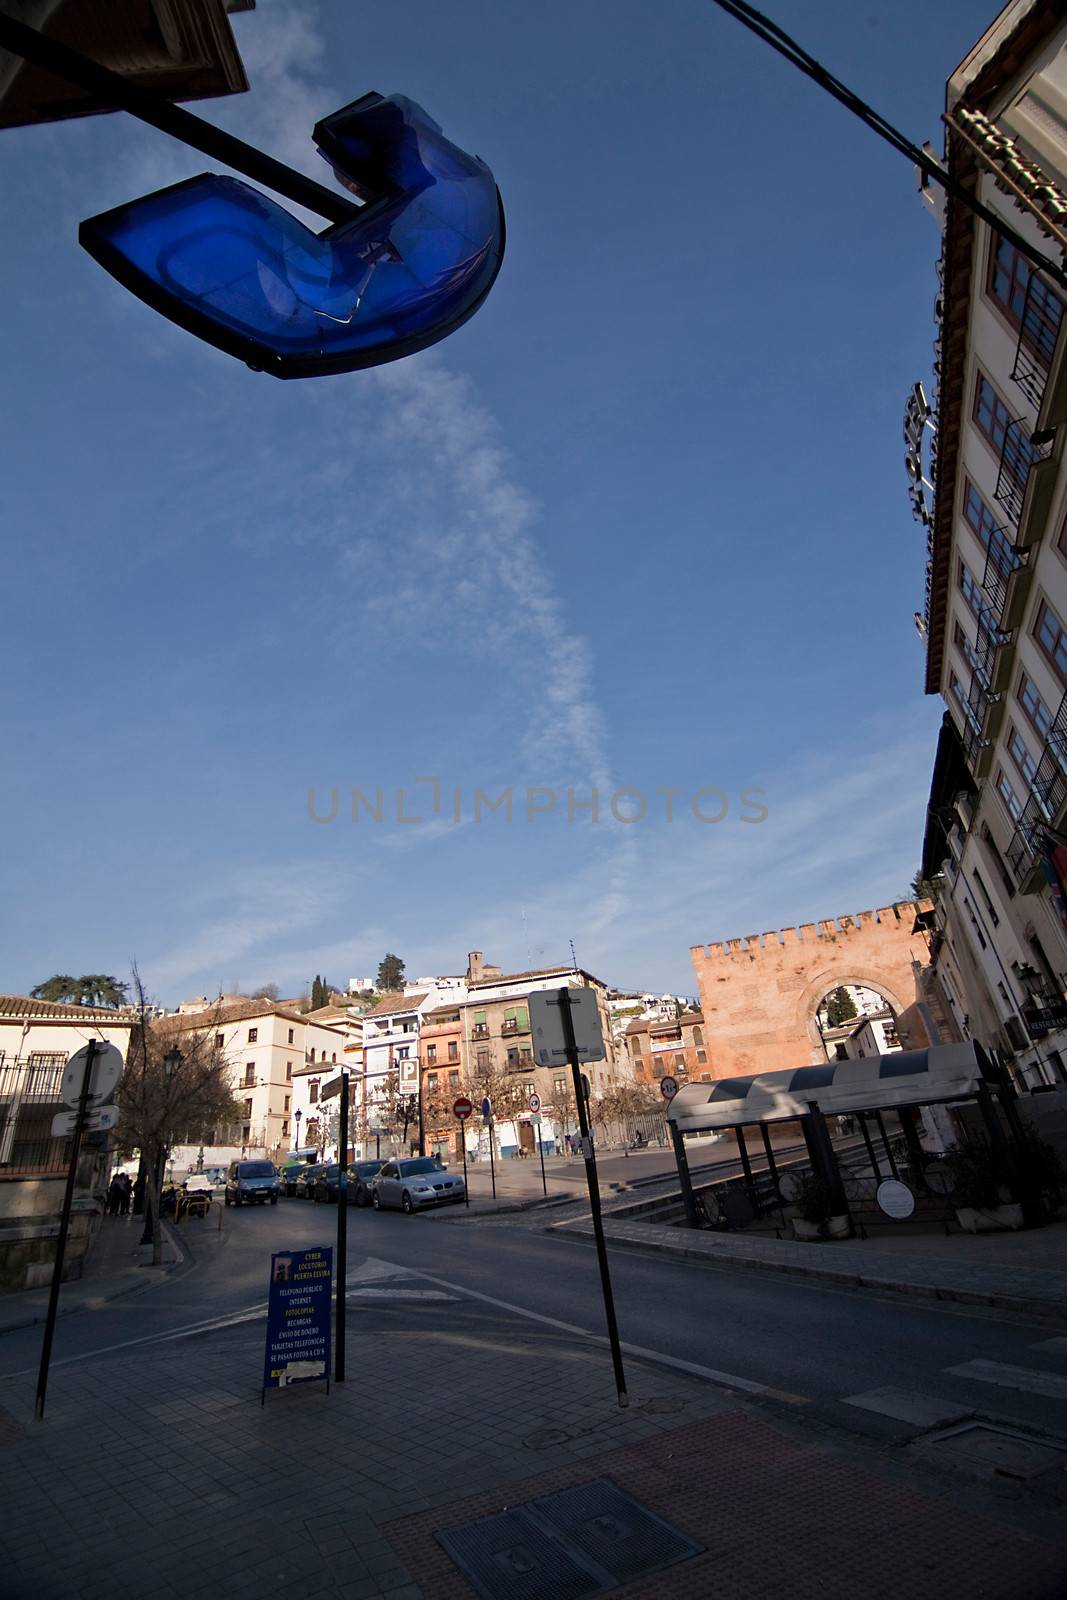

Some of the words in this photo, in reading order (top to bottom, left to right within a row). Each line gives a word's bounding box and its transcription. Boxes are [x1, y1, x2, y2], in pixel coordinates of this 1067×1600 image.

[404, 1062, 415, 1079] P
[299, 1261, 327, 1270] LOCUTORIO
[294, 1272, 310, 1280] PUERTA
[311, 1270, 330, 1279] ELVIRA
[289, 1297, 311, 1305] INTERNET
[285, 1307, 314, 1316] FOTOCOPIAS
[287, 1319, 311, 1327] RECARGAS
[301, 1327, 319, 1335] DINERO
[271, 1341, 294, 1351] TARJETAS
[271, 1354, 277, 1362] SE
[277, 1351, 293, 1361] PASAN
[293, 1349, 309, 1358] FOTOS
